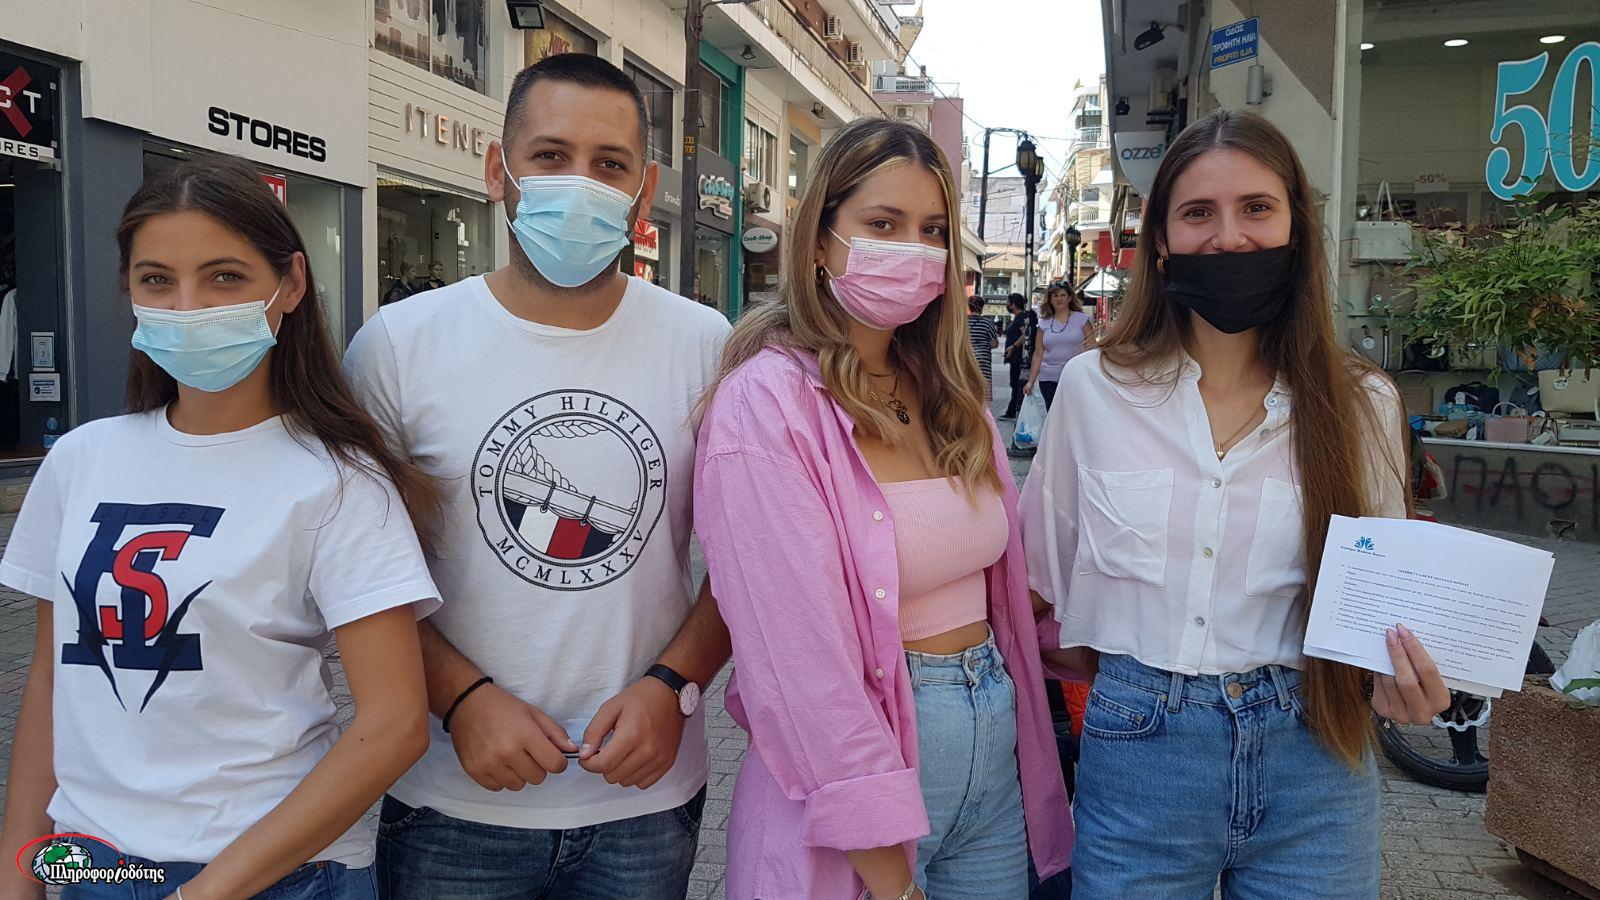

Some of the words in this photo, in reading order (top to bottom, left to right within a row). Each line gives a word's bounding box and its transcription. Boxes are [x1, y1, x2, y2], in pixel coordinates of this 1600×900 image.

[1225, 24, 1244, 37] ΟΔΟΣ
[0, 140, 39, 158] RES
[208, 106, 327, 163] STORES
[479, 405, 537, 498] TOMMY
[560, 396, 663, 490] HILFIGER
[495, 529, 644, 585] MCMLXXXV
